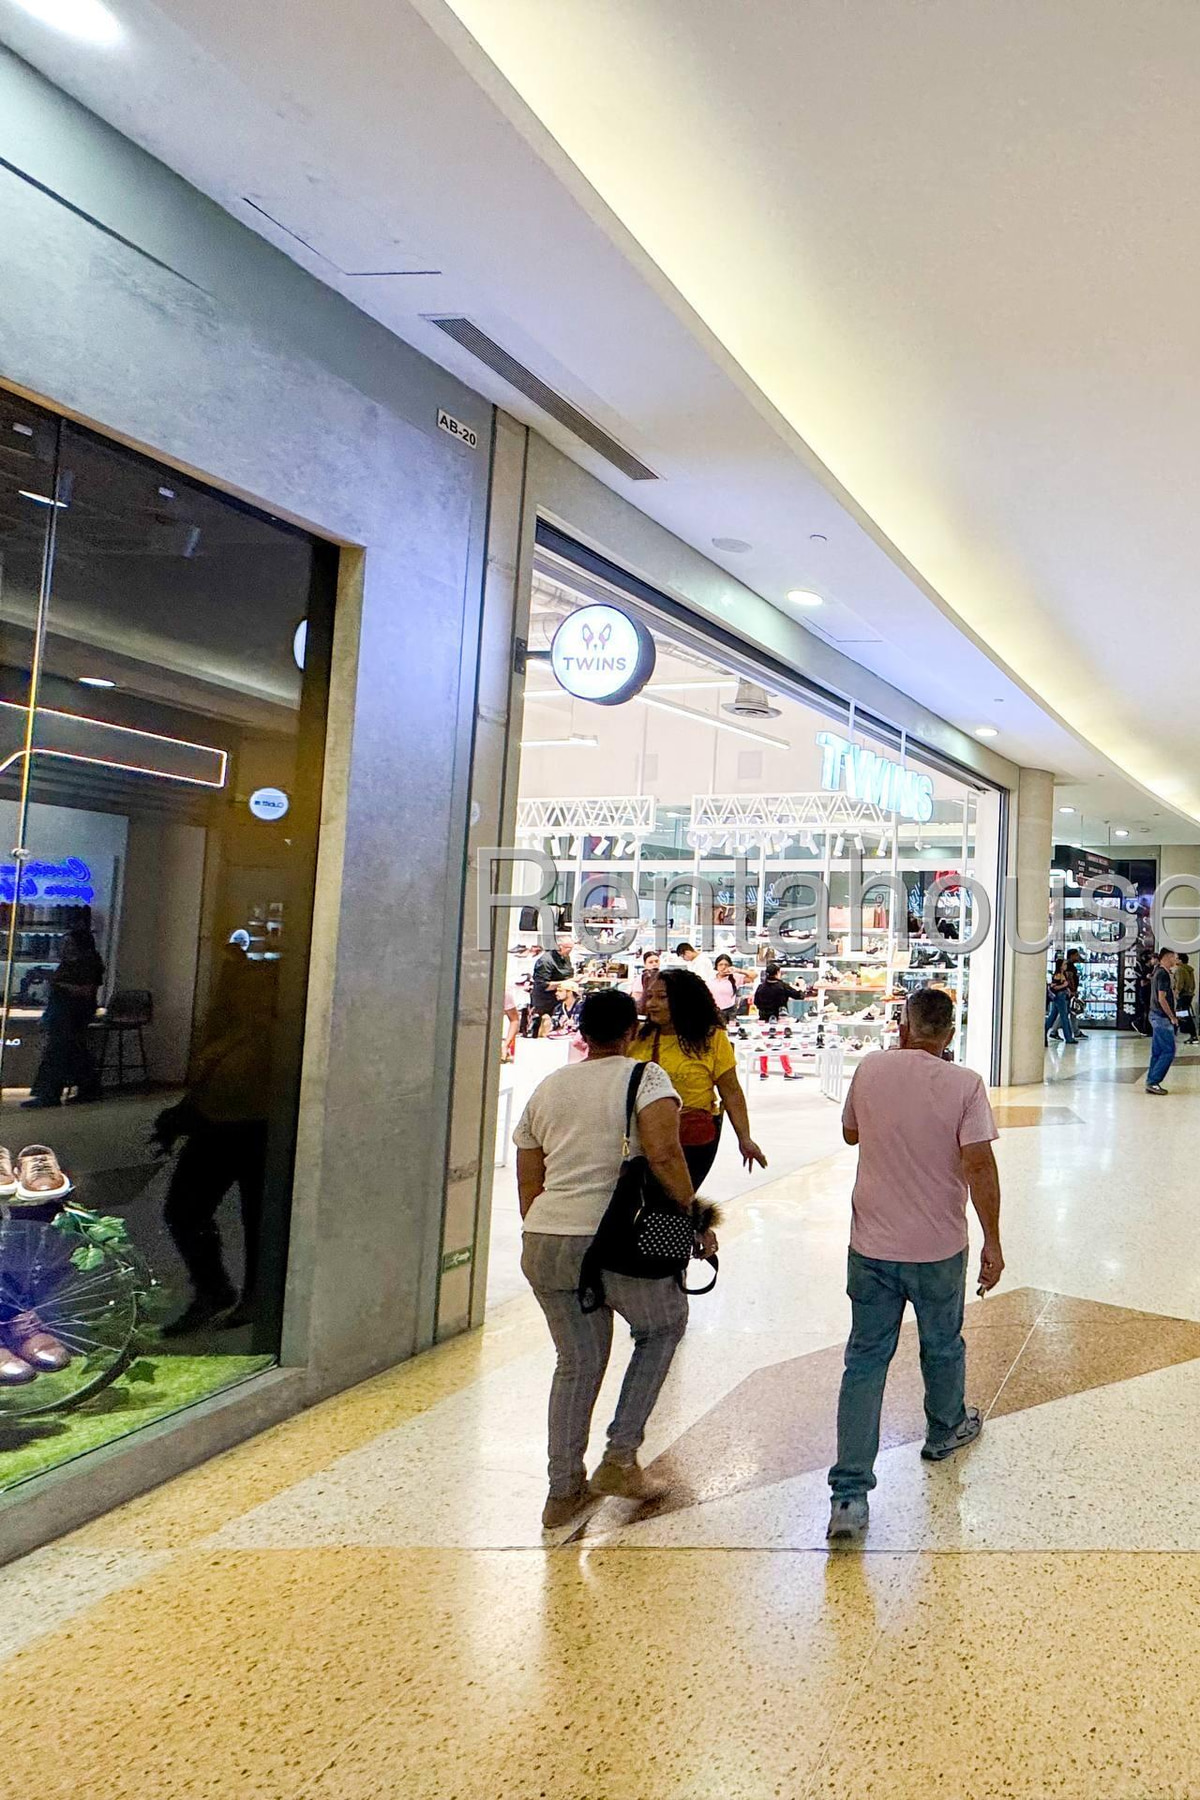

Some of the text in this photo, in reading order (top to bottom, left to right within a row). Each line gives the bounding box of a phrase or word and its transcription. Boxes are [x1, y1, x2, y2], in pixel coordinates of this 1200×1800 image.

[440, 415, 476, 446] AB-20
[563, 657, 626, 671] TWINS
[816, 731, 934, 822] TWINS
